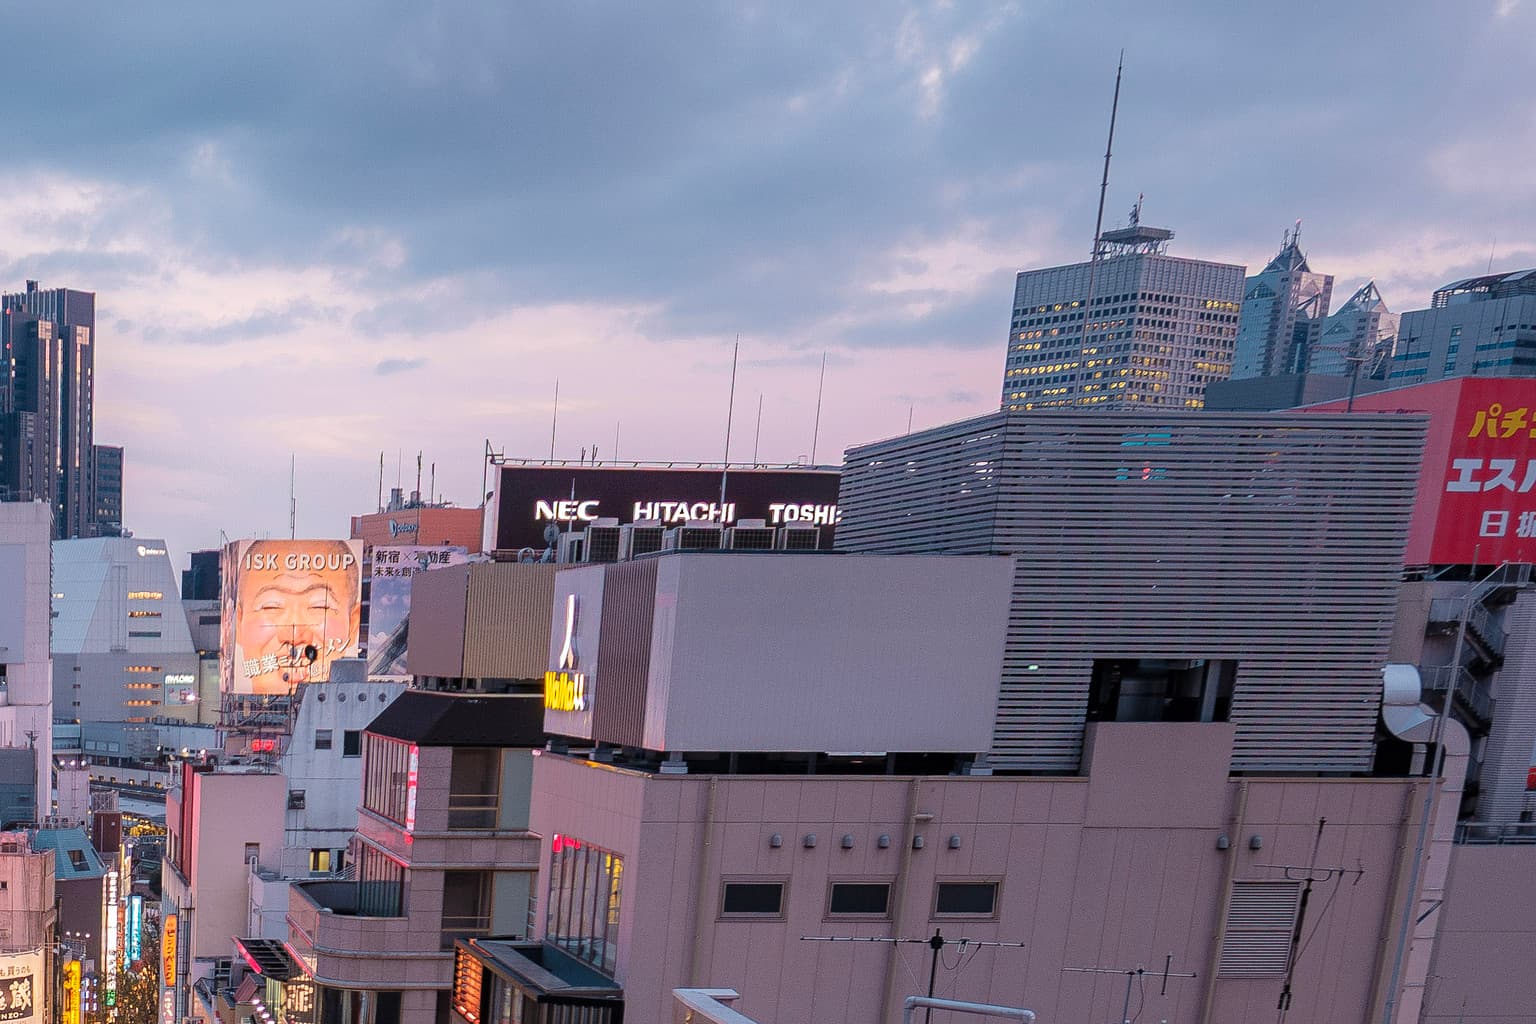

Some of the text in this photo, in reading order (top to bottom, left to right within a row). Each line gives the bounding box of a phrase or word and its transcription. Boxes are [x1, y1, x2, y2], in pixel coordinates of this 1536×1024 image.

[535, 500, 599, 521] NEC
[633, 501, 735, 522] HITACHI
[769, 503, 841, 525] TOSHI
[246, 553, 355, 571] ISK GROUP
